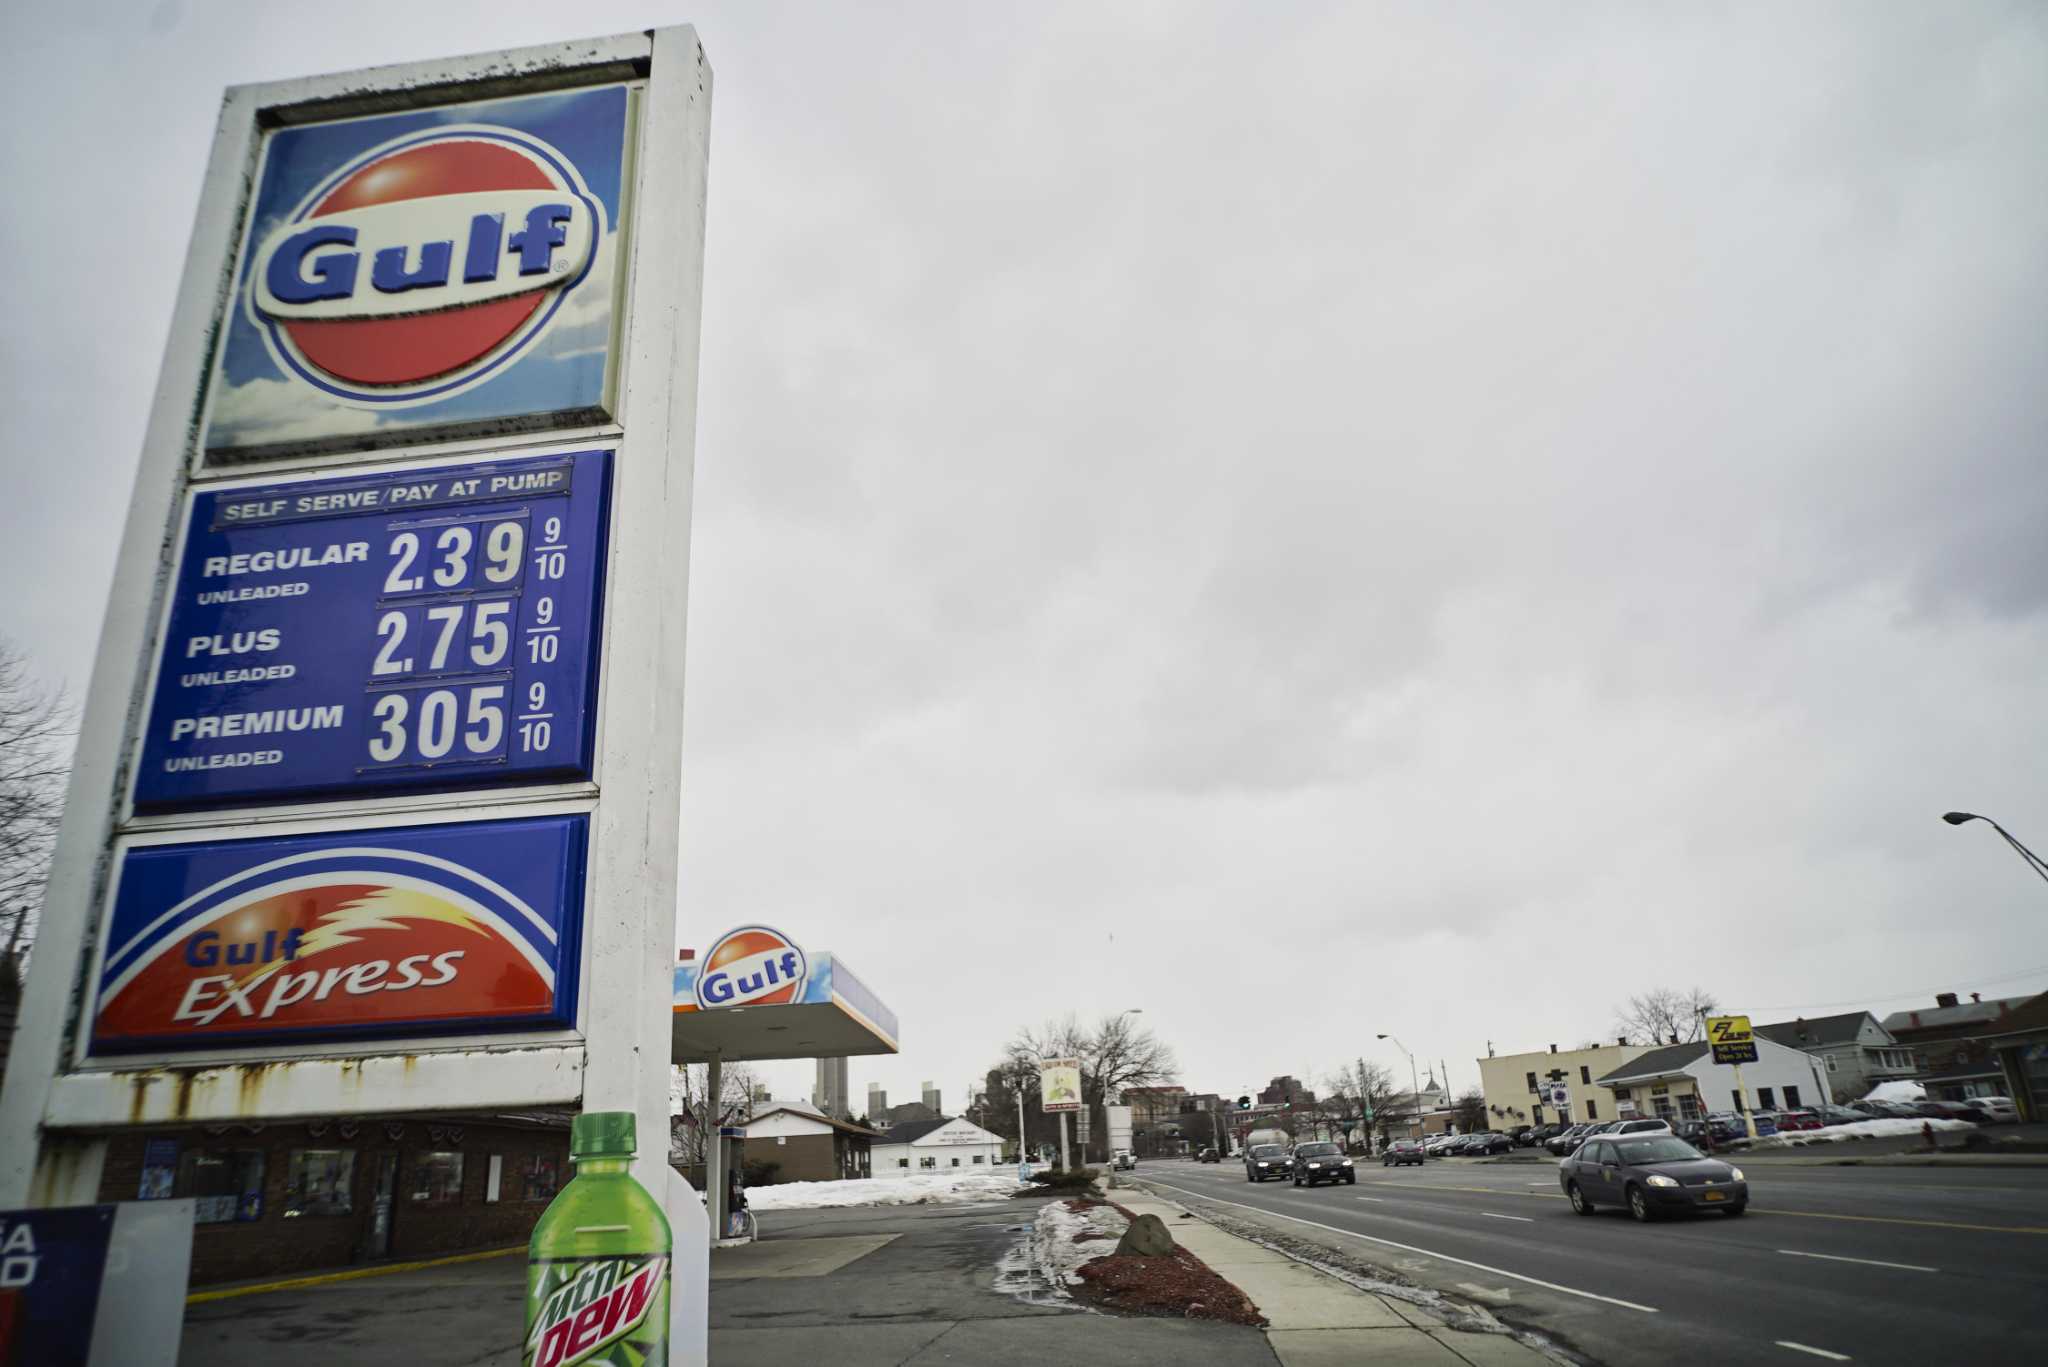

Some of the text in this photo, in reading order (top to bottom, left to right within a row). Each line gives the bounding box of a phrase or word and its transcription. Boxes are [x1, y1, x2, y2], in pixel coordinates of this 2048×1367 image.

[266, 205, 572, 304] Gulf
[224, 500, 287, 521] SELF
[448, 479, 480, 499] AT
[490, 471, 564, 494] PUMP
[543, 517, 561, 543] 9
[204, 542, 369, 577] REGULAR
[383, 520, 525, 594] 2.39
[536, 552, 566, 581] 10
[197, 582, 310, 605] UNLEADED
[536, 597, 554, 625] 9
[186, 629, 281, 659] PLUS
[372, 601, 511, 677] 2.75
[528, 635, 559, 665] 10
[181, 665, 296, 687] UNLEADED
[528, 682, 546, 712] 9
[170, 705, 345, 742] PREMIUM
[519, 721, 551, 753] 10
[164, 750, 284, 774] UNLEADED
[186, 930, 304, 967] Gulf
[173, 949, 465, 1026] Express
[703, 952, 796, 1003] Gulf
